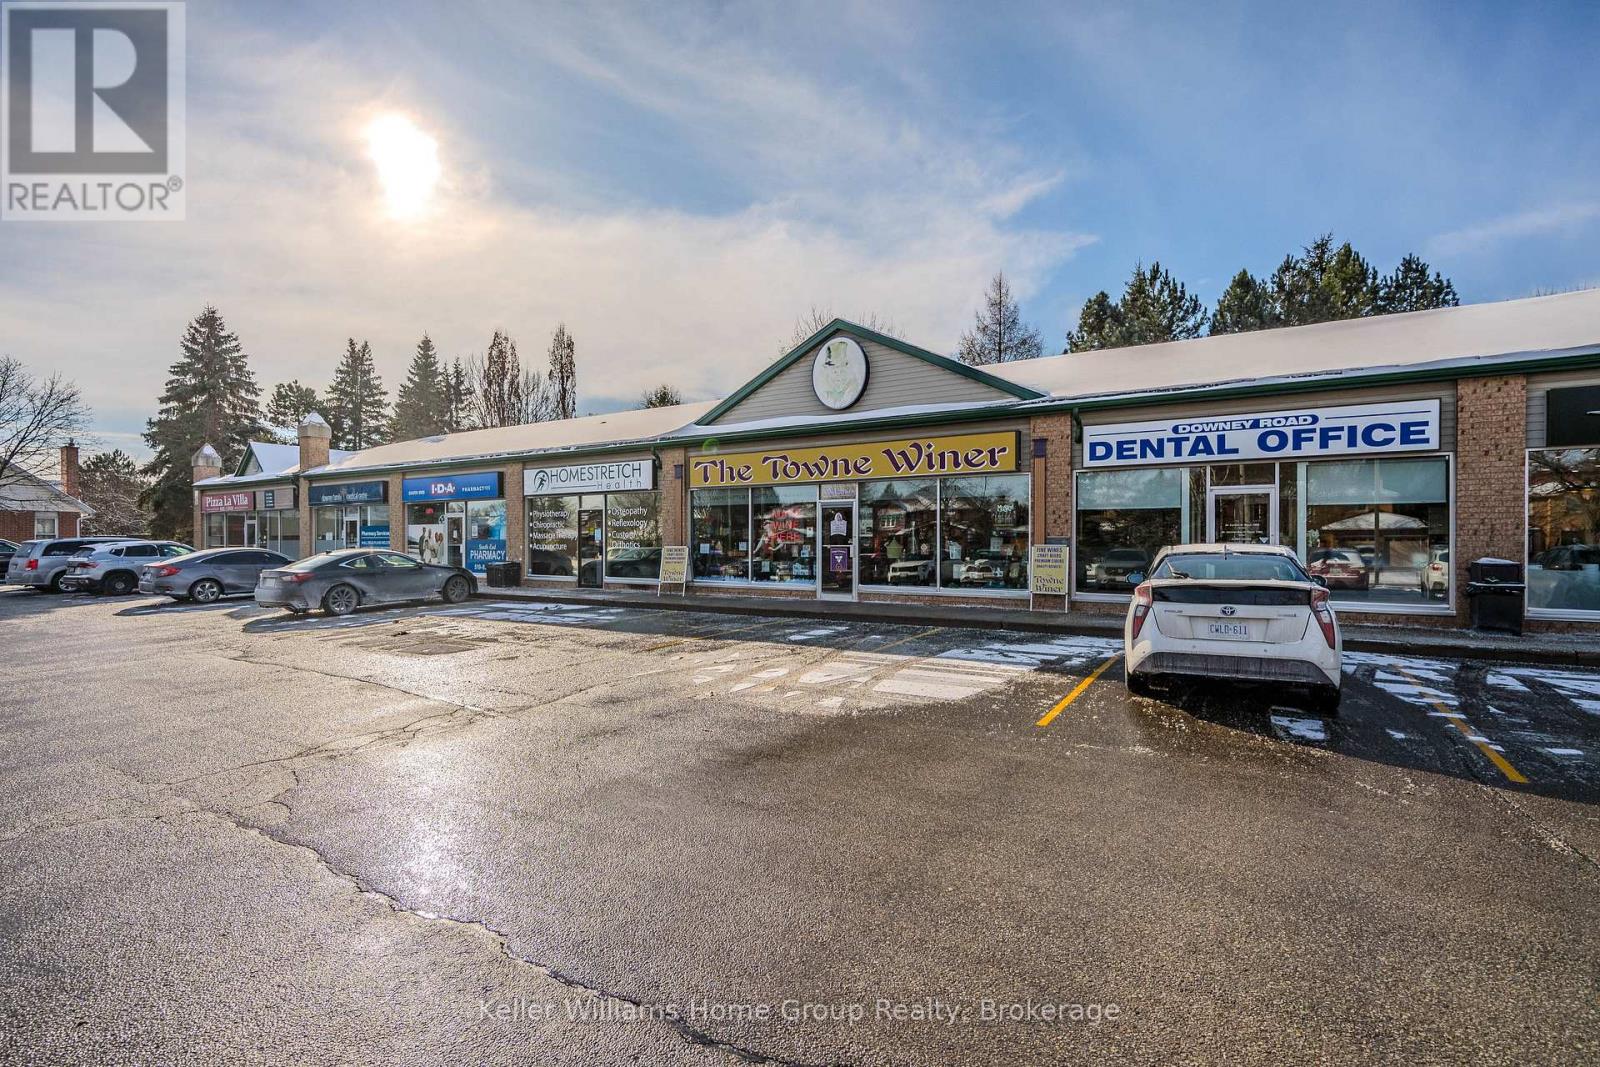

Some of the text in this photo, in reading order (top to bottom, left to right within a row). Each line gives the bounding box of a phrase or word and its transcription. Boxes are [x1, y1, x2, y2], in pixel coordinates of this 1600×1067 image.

[1178, 414, 1314, 433] DOWNEY ROAD
[1088, 420, 1431, 462] DENTAL OFFICE
[693, 441, 1009, 484] The Towne Winer
[550, 463, 642, 484] HOMESTRETCH
[597, 480, 642, 490] Health
[206, 493, 248, 507] Pizza La Villa
[532, 510, 570, 519] Physiotherapy
[611, 506, 648, 517] Osteopathy
[532, 520, 565, 529] Chiropractic
[611, 518, 648, 530] Reflexology
[470, 550, 506, 560] PHARMACY
